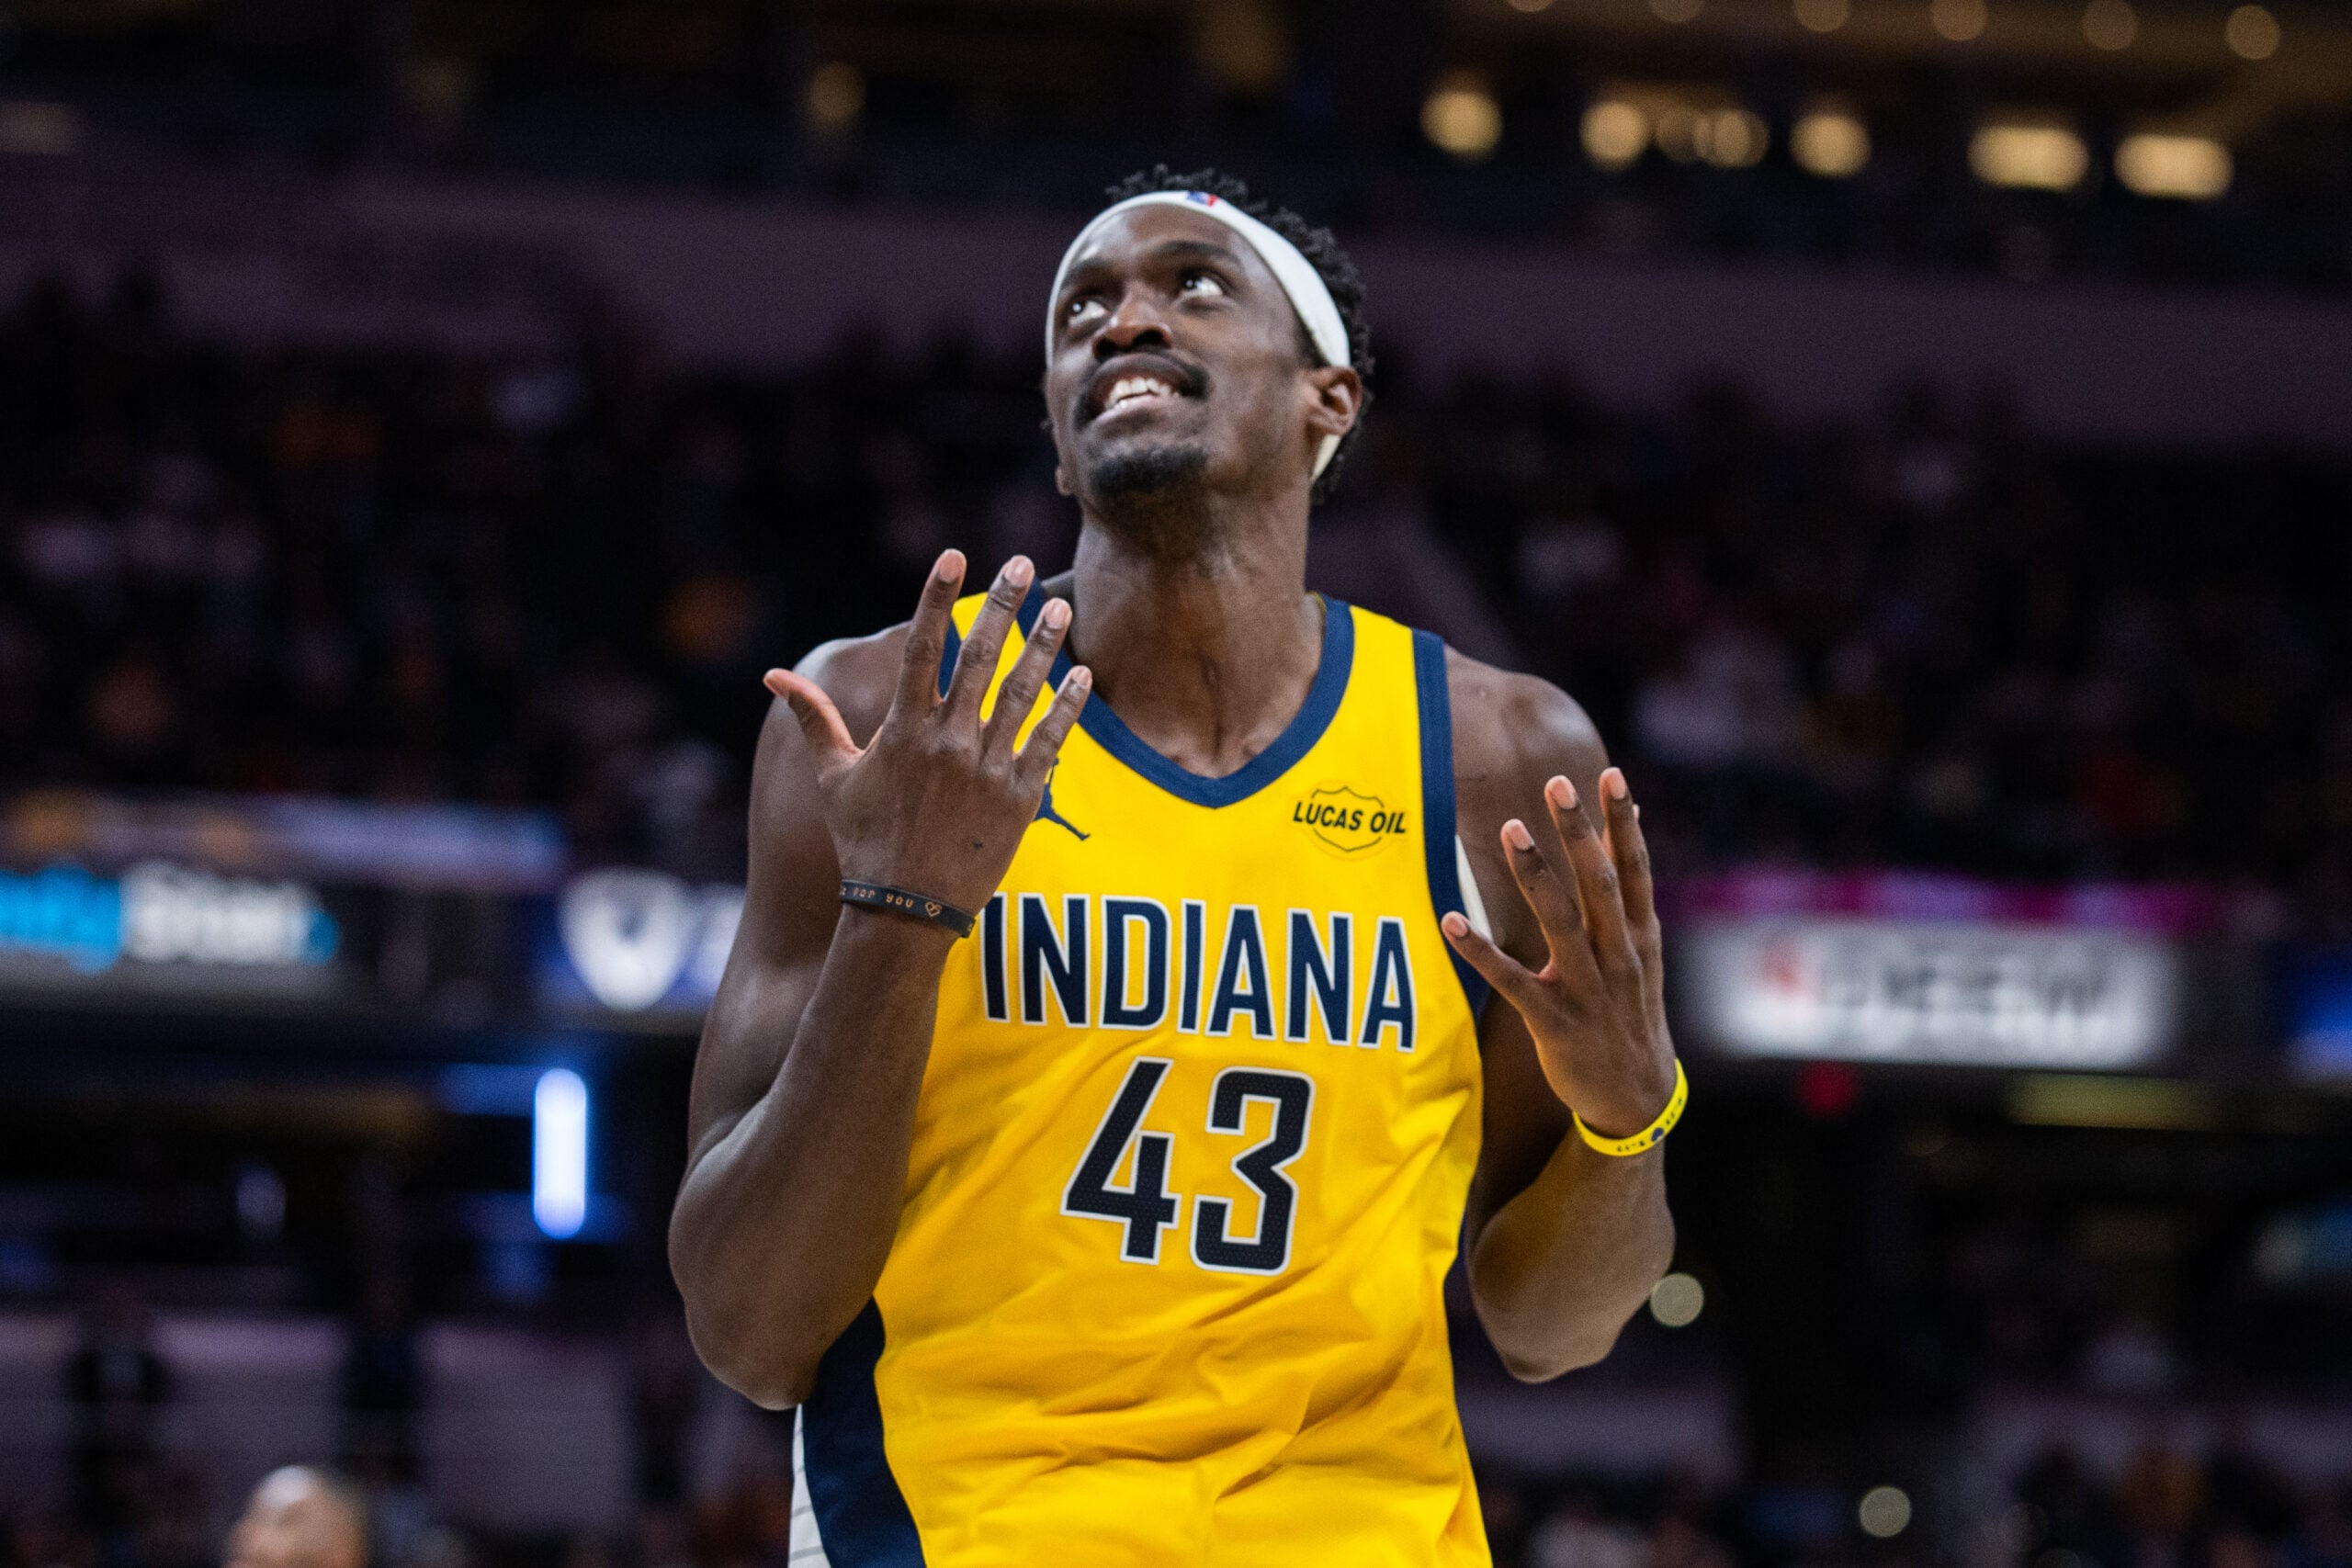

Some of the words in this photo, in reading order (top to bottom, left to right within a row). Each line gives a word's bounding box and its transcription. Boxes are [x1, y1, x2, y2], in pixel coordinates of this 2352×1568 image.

[1293, 800, 1363, 831] LUCAS
[1370, 810, 1407, 834] OIL
[979, 891, 1417, 1054] INDIANA
[1059, 1055, 1316, 1276] 43
